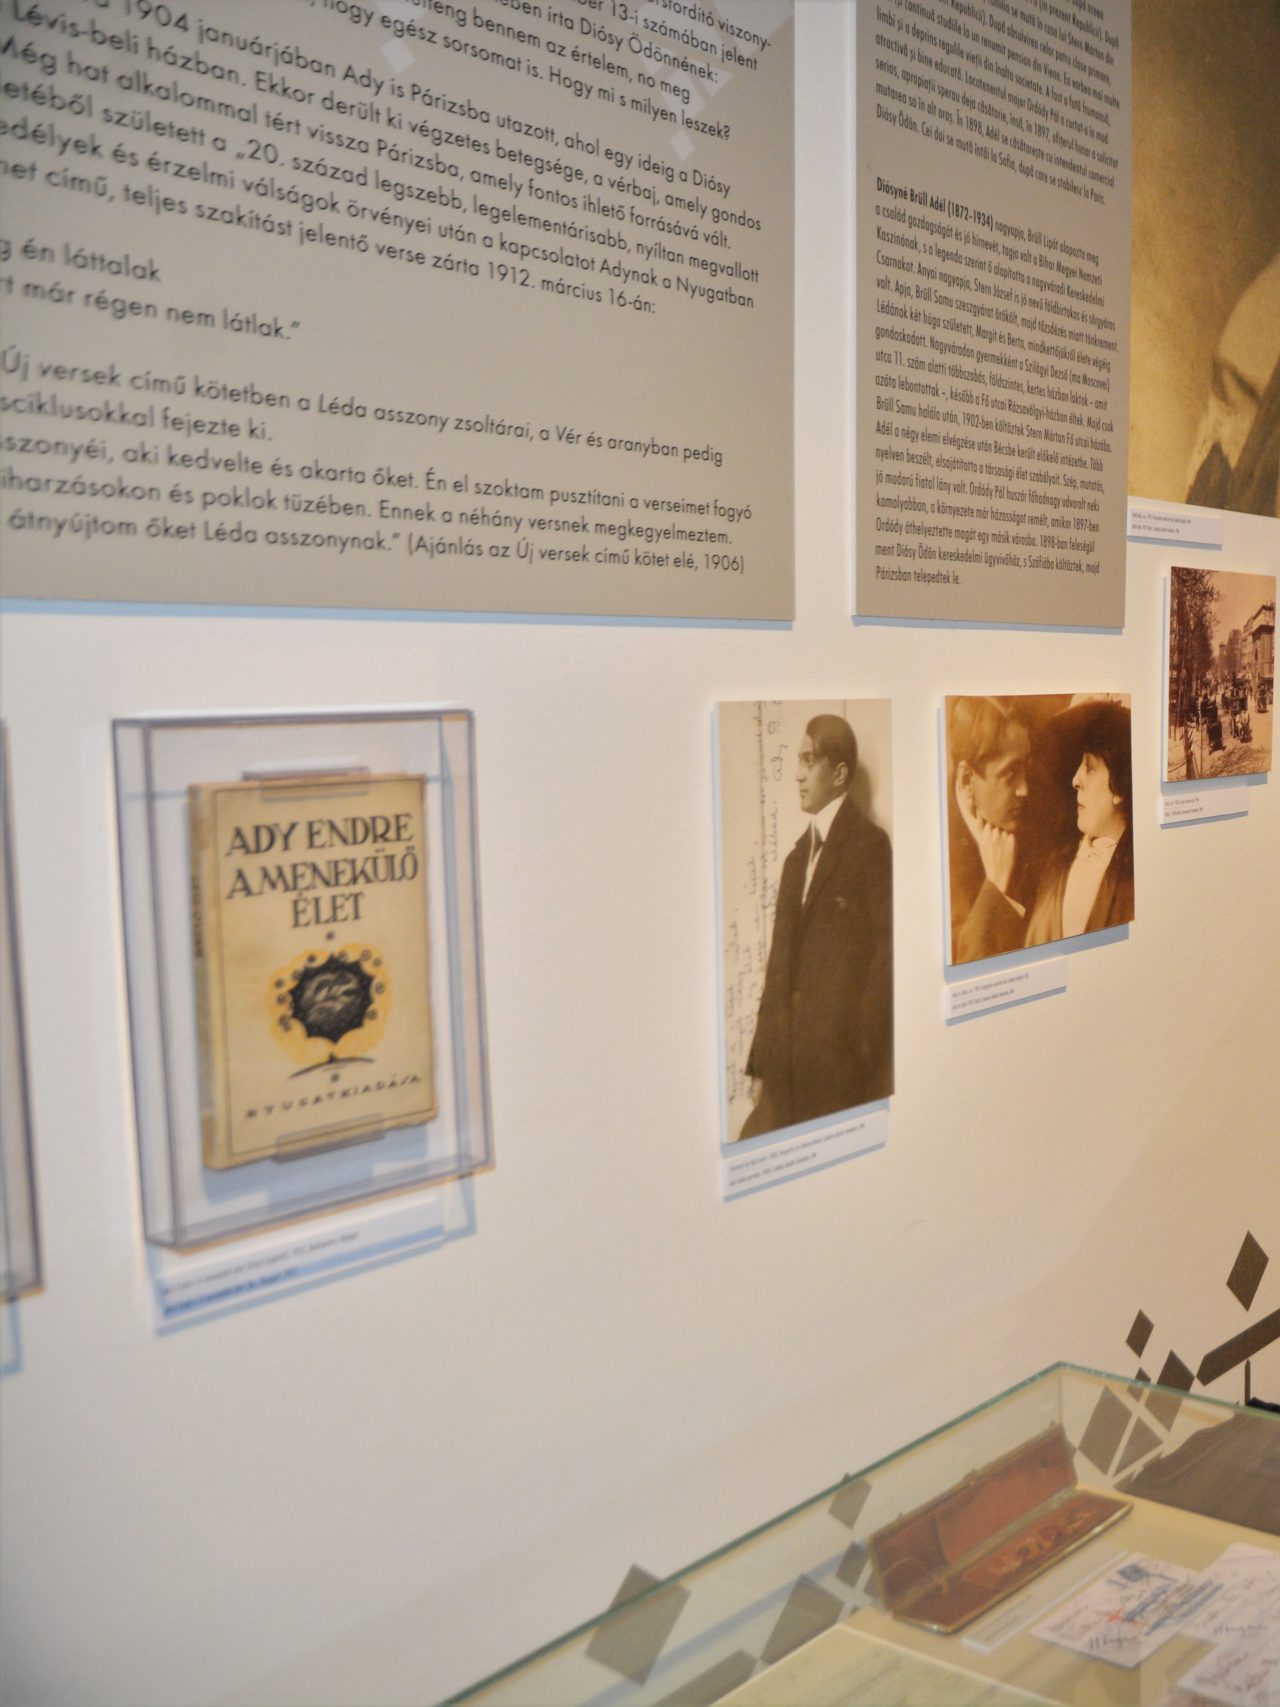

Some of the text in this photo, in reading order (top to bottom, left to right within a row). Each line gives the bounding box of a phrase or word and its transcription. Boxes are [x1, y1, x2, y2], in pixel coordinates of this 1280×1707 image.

[473, 8, 690, 104] bennem az értelem, no meg
[547, 6, 717, 81] írta Diósy Ödönnének:
[612, 0, 639, 25] 13-i
[643, 17, 717, 56] számában
[720, 46, 758, 71] jelent
[718, 19, 772, 51] viszony-
[128, 0, 730, 198] 1904 januárjában Ady is Párizsba utazott, ahol egy ideig a Diósy
[380, 16, 730, 140] egész sorsomat is. Hogy mi s milyen leszek?
[147, 38, 245, 85] házban.
[255, 71, 314, 103] Ekkor
[321, 91, 380, 123] derült
[386, 107, 402, 129] ki
[409, 121, 490, 154] végzetes
[496, 140, 587, 183] betegsége,
[593, 174, 603, 186] a
[608, 177, 660, 205] vérbaj,
[664, 195, 708, 219] amely
[712, 208, 761, 230] gondos
[45, 169, 655, 313] című, teljes szakítást jelentő verse zárta 1912. március 16-án:
[876, 177, 908, 200] Diósyné
[909, 188, 928, 207] Brüll
[929, 195, 946, 213] Adél
[995, 221, 1026, 241] nagyapja,
[1027, 228, 1042, 245] Brüll
[1043, 234, 1059, 250] Lipót
[1059, 241, 1085, 260] alapozta
[1086, 252, 1099, 267] meg
[21, 239, 159, 281] én láttalak
[23, 282, 300, 339] már régen nem látlak.”
[1, 346, 723, 467] Új versek című kötetben a Léda asszony zsoltárai, a Vér és aranyban pedig
[162, 407, 272, 440] fejezte ki.
[9, 510, 744, 574] átnyújtom őket Léda asszonynak.” (Ajánlás az Új versek című kötet elé, 1906)
[875, 565, 961, 585] Párizsban telepedtek le.
[226, 812, 414, 856] ADY ENDRE
[292, 892, 364, 929] ÉLET
